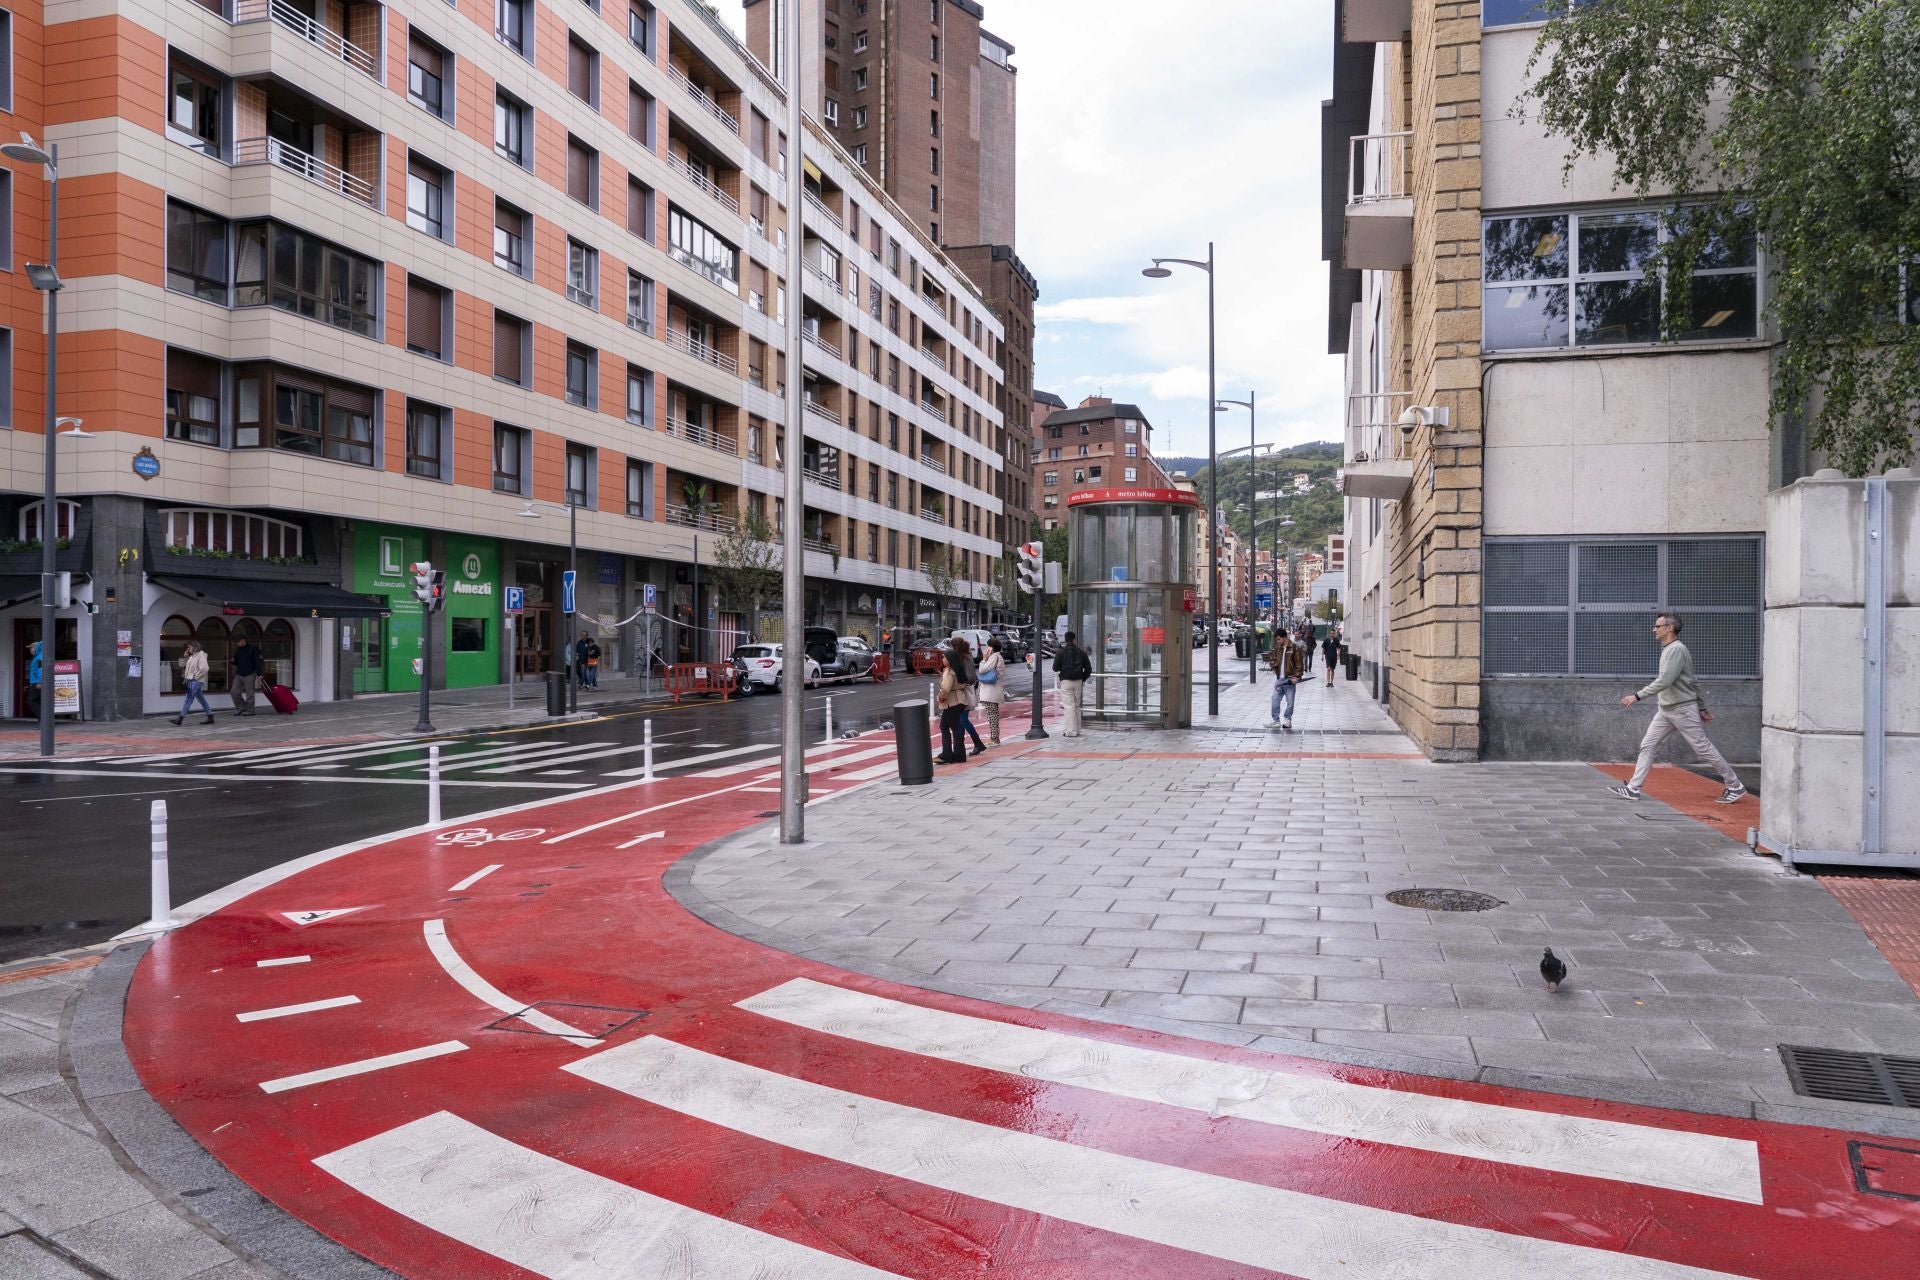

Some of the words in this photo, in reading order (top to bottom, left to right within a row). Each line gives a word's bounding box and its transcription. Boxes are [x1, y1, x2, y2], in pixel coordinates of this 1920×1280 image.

[1137, 490, 1156, 498] bilbao
[384, 541, 400, 572] L
[373, 580, 405, 588] Autoescuela
[453, 581, 491, 595] Amezti
[509, 588, 520, 608] P
[647, 586, 654, 603] P
